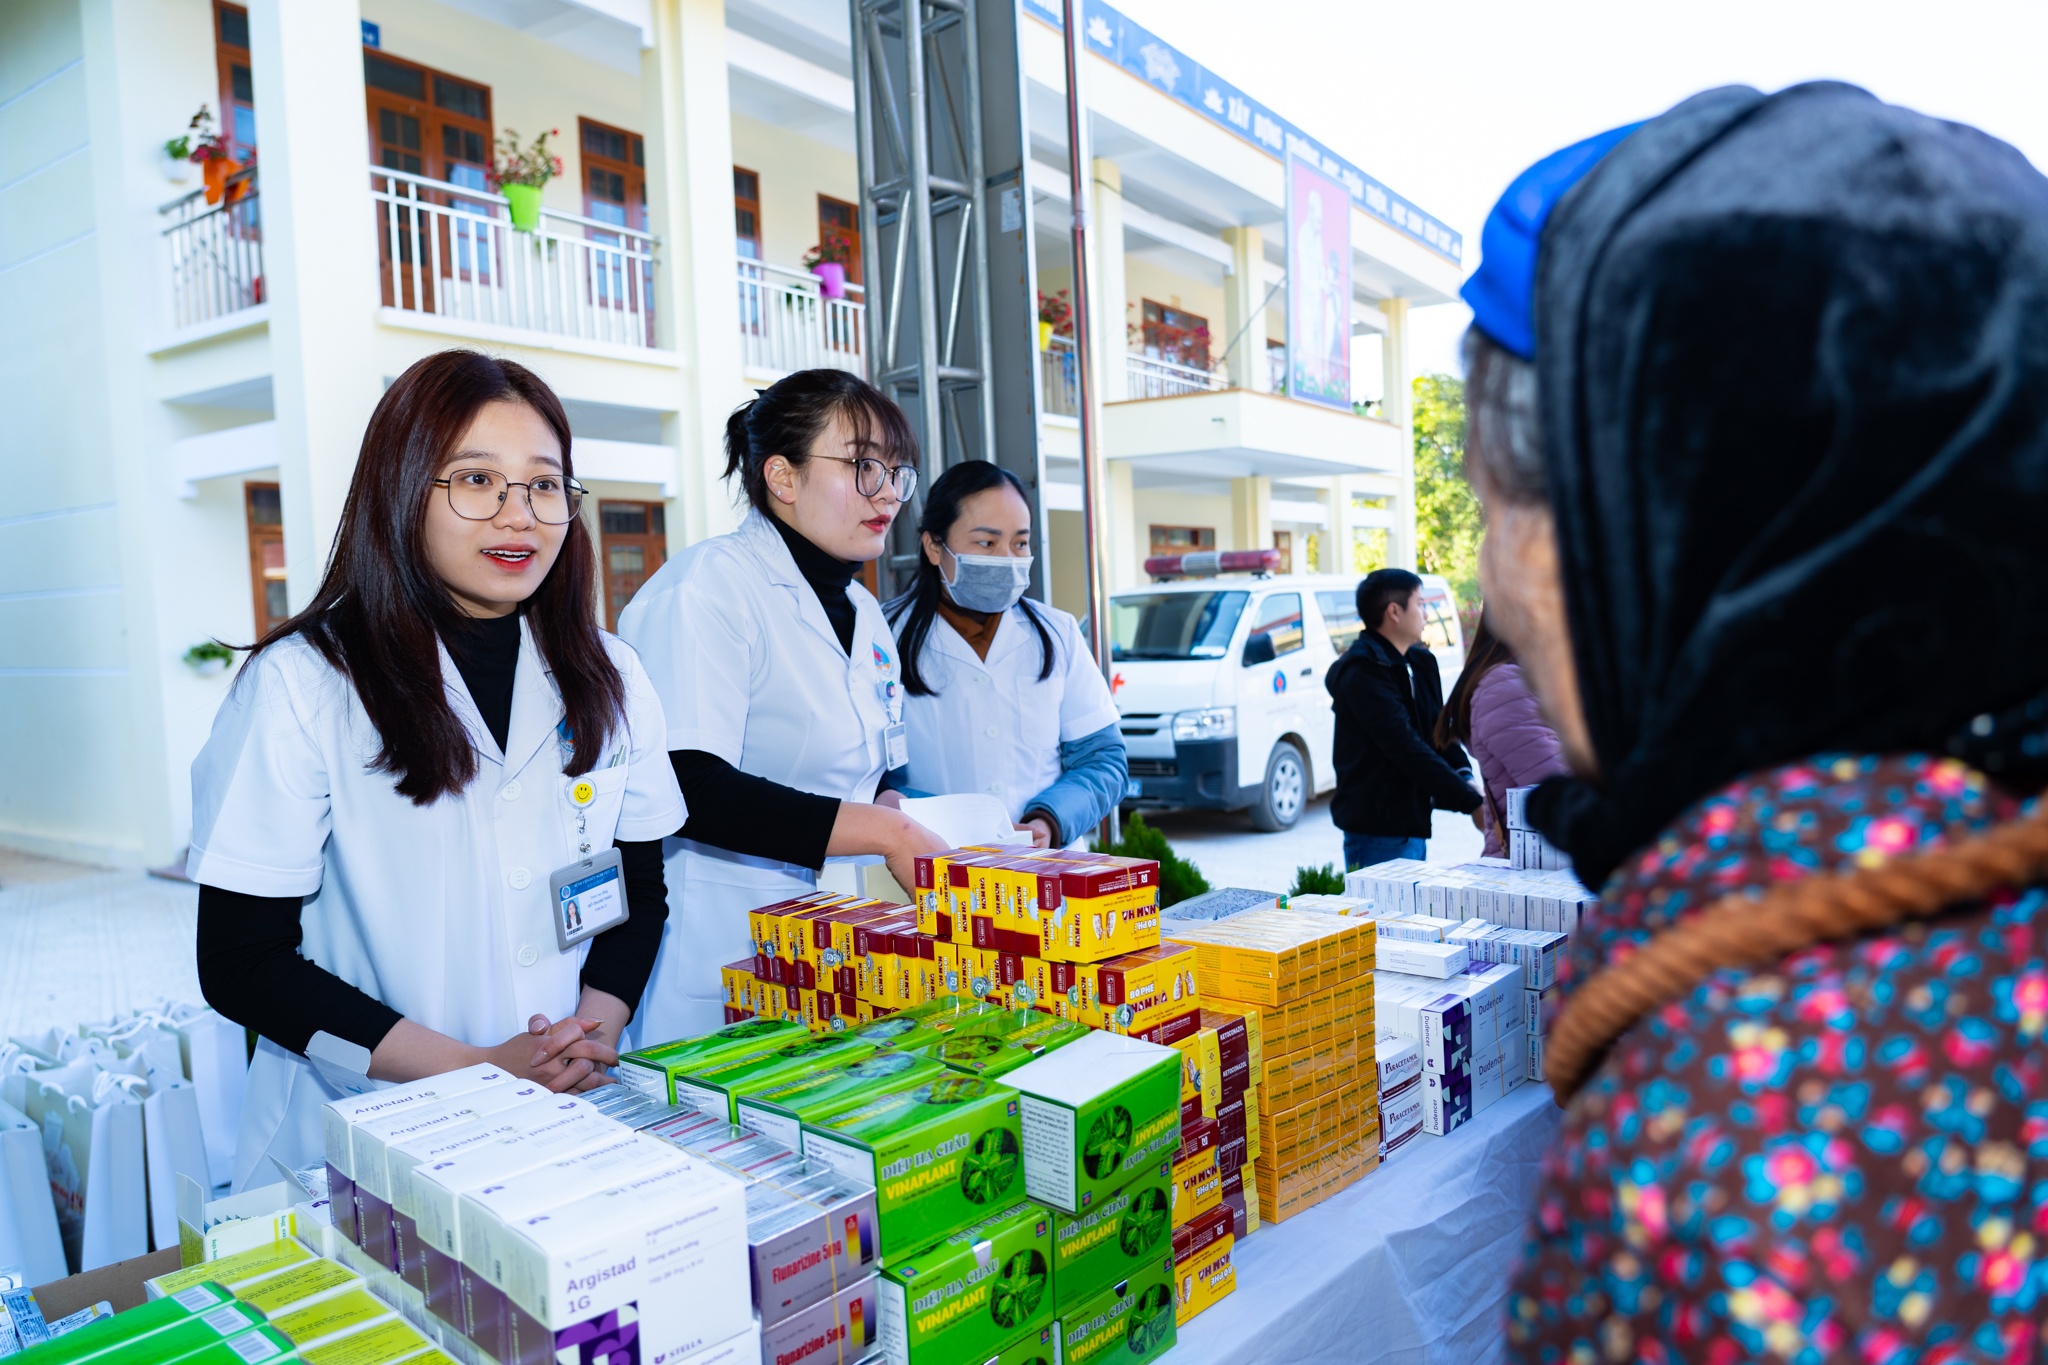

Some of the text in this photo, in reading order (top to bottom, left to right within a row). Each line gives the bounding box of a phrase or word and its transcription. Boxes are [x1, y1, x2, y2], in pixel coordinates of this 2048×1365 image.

[1122, 904, 1156, 923] NAM HÀ
[1129, 984, 1140, 1000] BỔ
[1478, 993, 1505, 1016] Dudencer
[1220, 1024, 1244, 1040] KETOCONAZOL
[1223, 1061, 1247, 1077] KETOCONAZOL
[1385, 1053, 1418, 1074] PARACETAMOL
[1478, 1052, 1507, 1076] Dudencer
[355, 1096, 414, 1115] Argistad
[1218, 1099, 1243, 1117] KETOCONAZOL
[1389, 1101, 1421, 1124] PARACETAMOL
[390, 1115, 449, 1136] Argistad
[1134, 1109, 1178, 1147] VINAPLANT
[430, 1132, 490, 1155] Argistad
[1220, 1135, 1245, 1153] KETOCONAZOL
[881, 1157, 913, 1181] DIỆP
[914, 1149, 934, 1167] HẠ
[935, 1132, 970, 1158] CHÂU
[885, 1159, 956, 1199] VINAPLANT
[1221, 1174, 1240, 1188] OCONAZOL
[1058, 1193, 1130, 1242] DIỆP HẠ CHÂU
[1061, 1218, 1118, 1258] VINAPLANT
[772, 1240, 842, 1284] Flunarizine 5mg
[566, 1256, 637, 1294] Argistad
[567, 1295, 591, 1314] 1G
[913, 1289, 944, 1314] DIỆP
[945, 1279, 965, 1298] HẠ
[917, 1286, 986, 1333] VINAPLANT
[1067, 1293, 1136, 1346] DIỆP HẠ CHÂU
[669, 1338, 703, 1358] STELLA
[776, 1324, 846, 1365] Flunarizine 5mg
[1070, 1318, 1125, 1362] VINAPLANT
